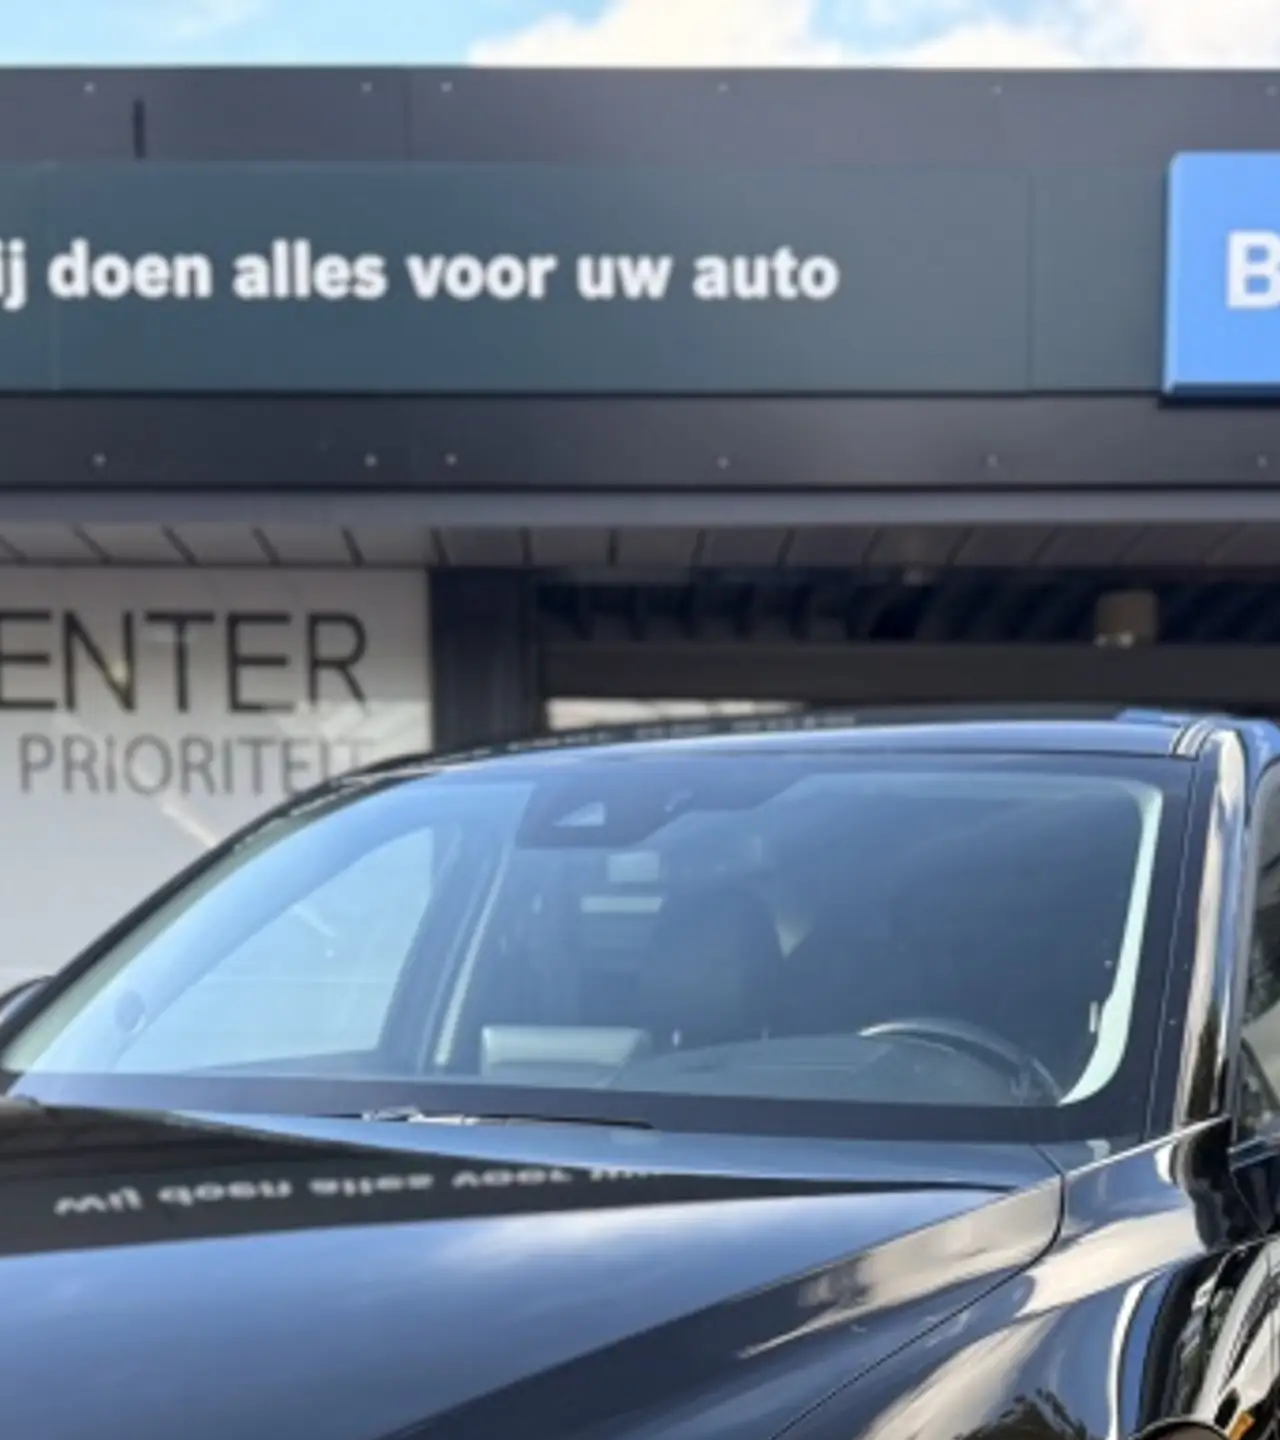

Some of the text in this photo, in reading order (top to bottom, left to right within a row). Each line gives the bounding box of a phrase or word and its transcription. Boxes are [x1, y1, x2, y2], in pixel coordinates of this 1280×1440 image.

[47, 238, 212, 299] doen
[232, 239, 387, 299] alles
[406, 253, 558, 299] voor
[576, 255, 673, 299] uw
[692, 246, 839, 299] auto
